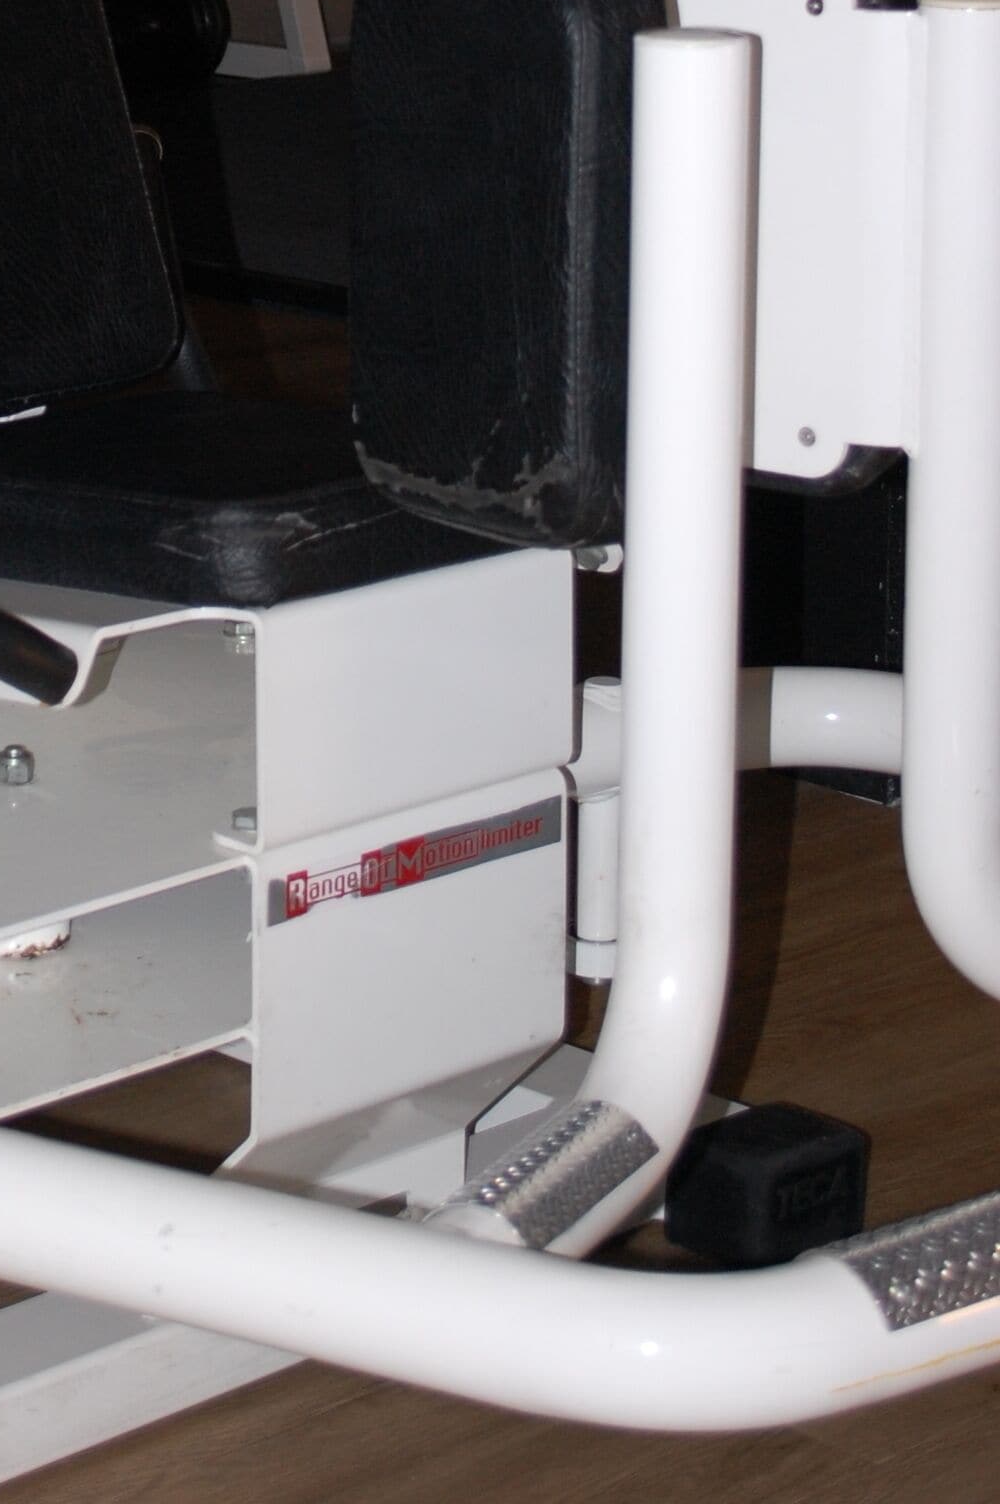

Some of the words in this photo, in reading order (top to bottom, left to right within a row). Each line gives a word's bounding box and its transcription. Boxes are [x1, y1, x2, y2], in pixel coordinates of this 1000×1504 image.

[286, 868, 358, 917] Range
[398, 836, 477, 883] Motion
[774, 1164, 849, 1224] TECA
